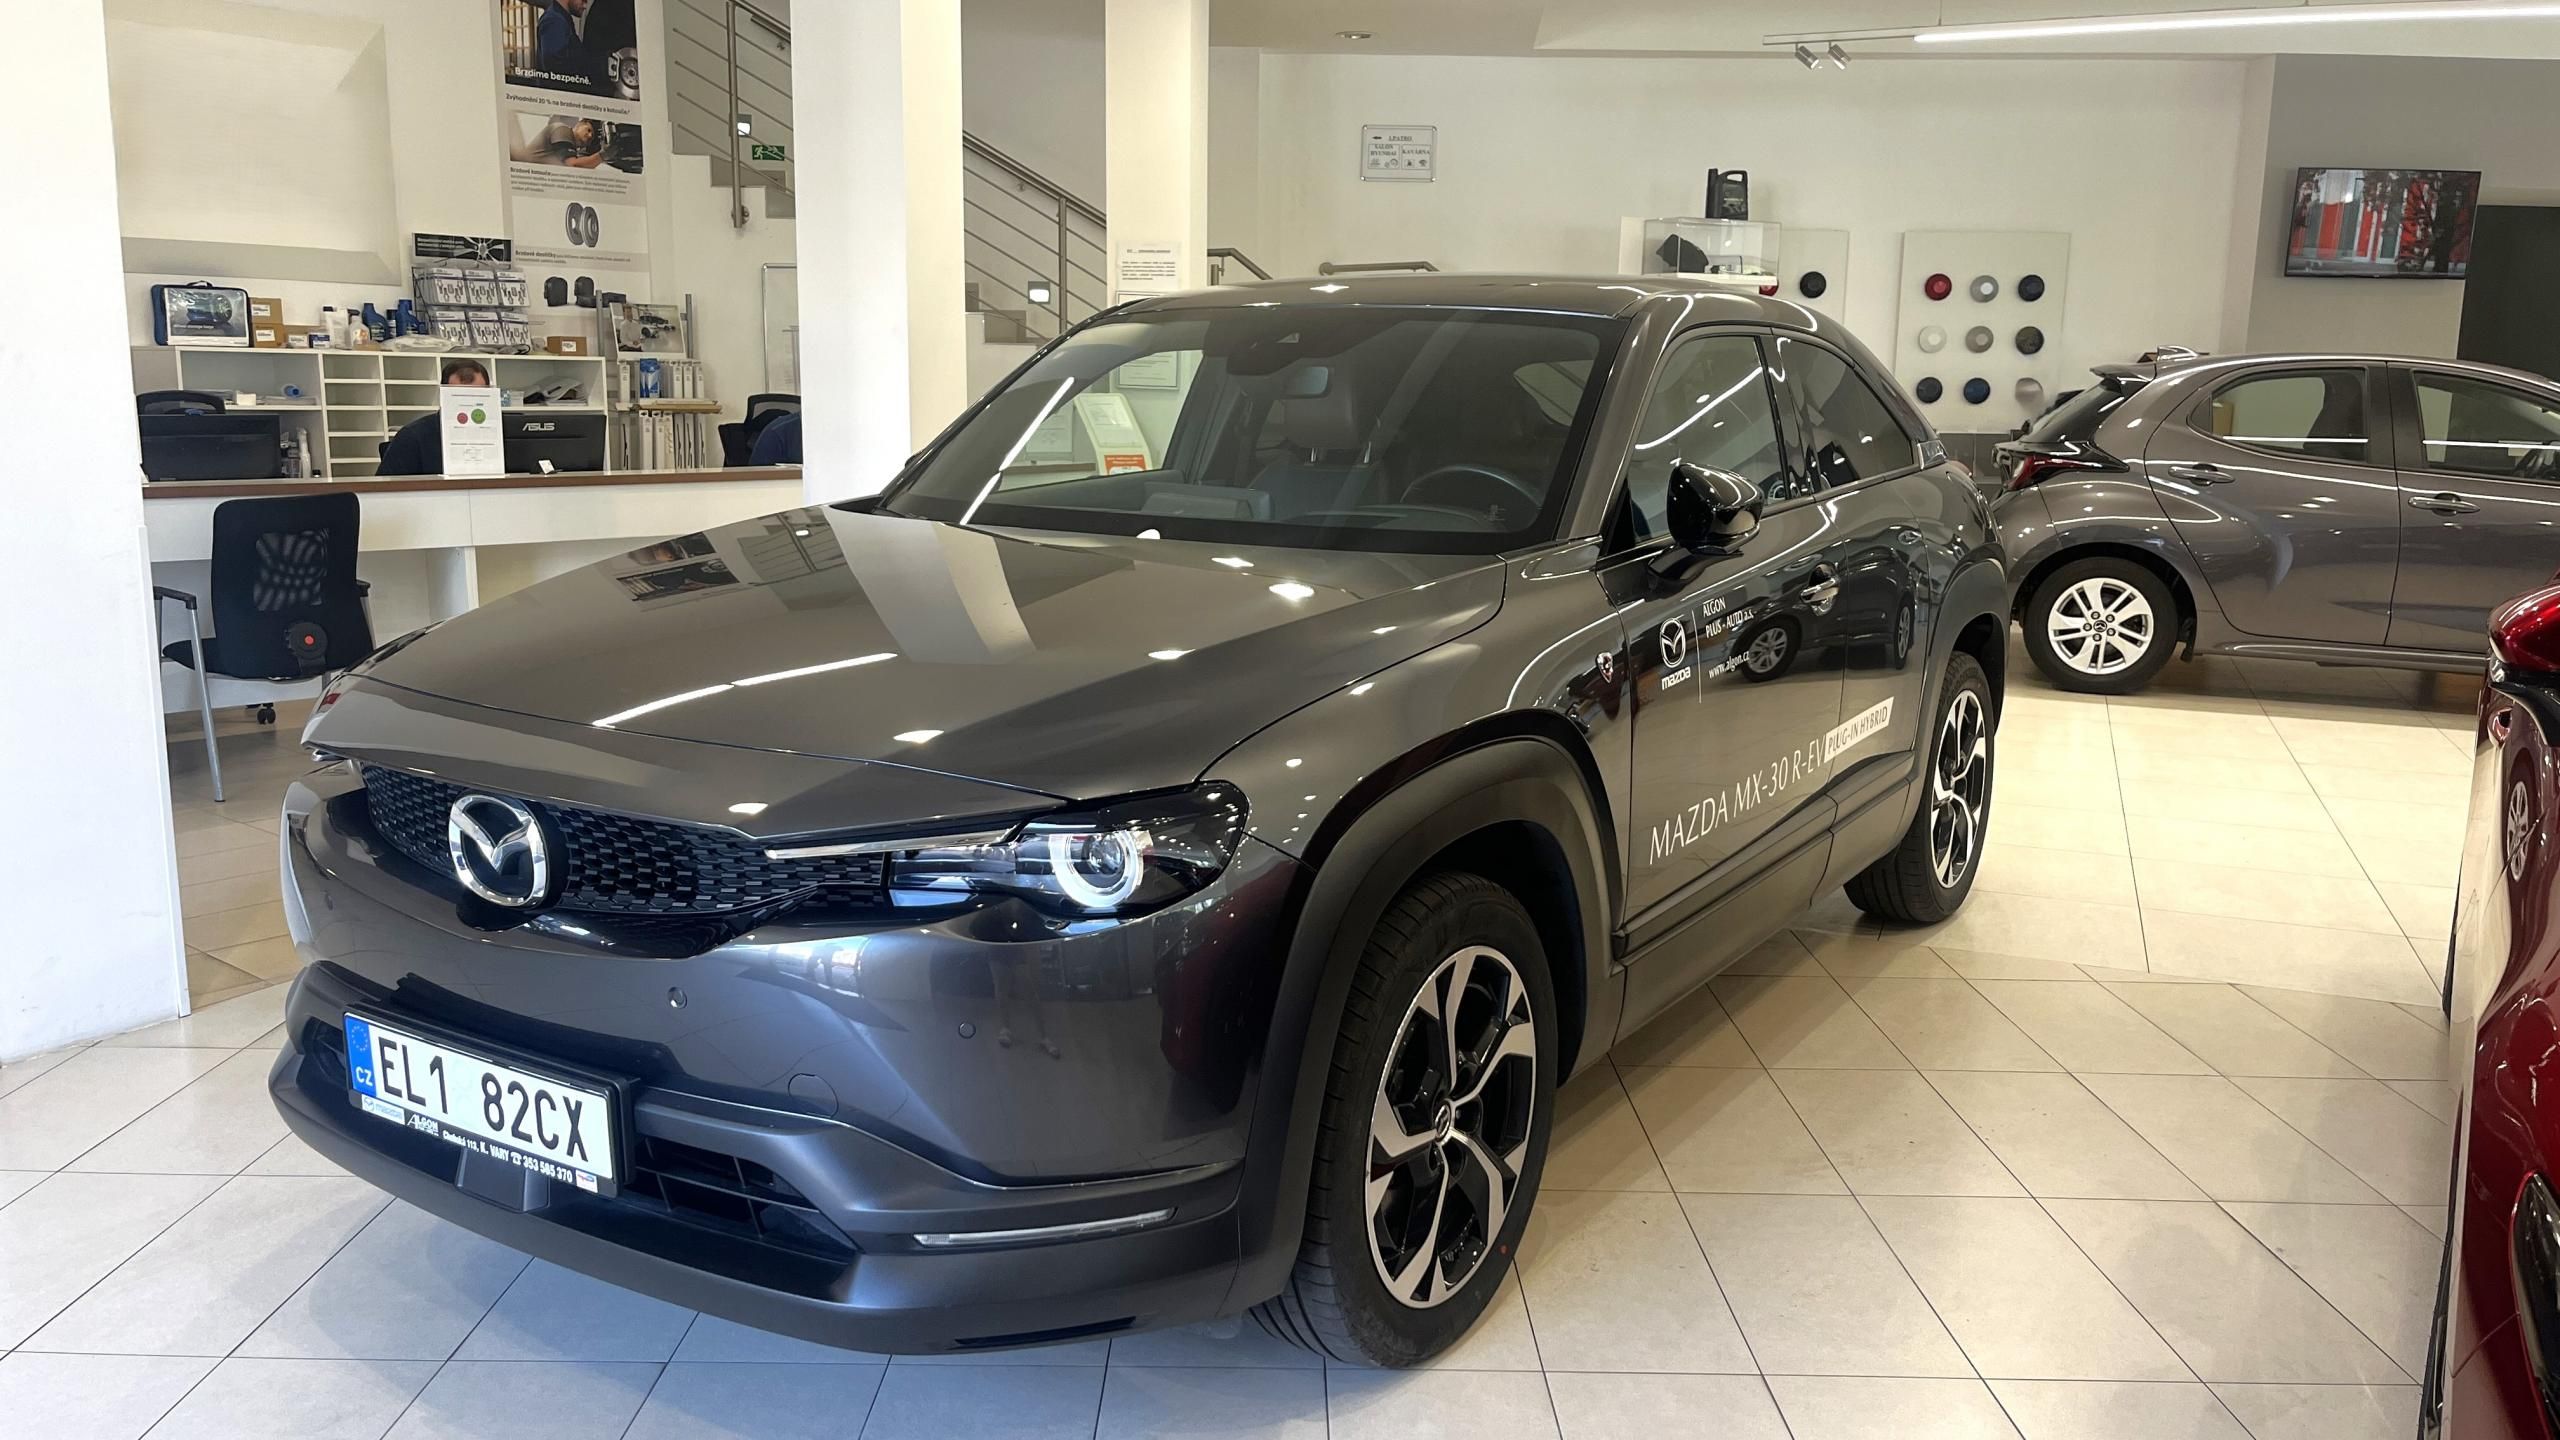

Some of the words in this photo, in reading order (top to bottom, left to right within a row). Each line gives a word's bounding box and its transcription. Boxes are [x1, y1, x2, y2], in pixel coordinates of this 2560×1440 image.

[515, 66, 549, 79] Brzdíme
[550, 71, 591, 85] bezpečně.
[522, 422, 555, 431] ASUS
[1702, 596, 1726, 618] ALGON
[1705, 619, 1721, 639] PLUS
[1726, 610, 1743, 629] AUTO
[1708, 650, 1750, 679] www.algon.cz
[1828, 721, 1859, 755] PLUG-IN
[1860, 706, 1888, 735] HYBRID
[1649, 790, 1728, 865] MAZDA
[1733, 756, 1788, 819] MX-30
[1792, 735, 1827, 784] R-EV
[355, 1066, 374, 1086] CZ
[378, 1036, 448, 1114] EL1
[481, 1072, 589, 1162] 82CX
[490, 1144, 509, 1162] VARY
[523, 1155, 539, 1172] 353
[556, 1166, 573, 1184] 370
